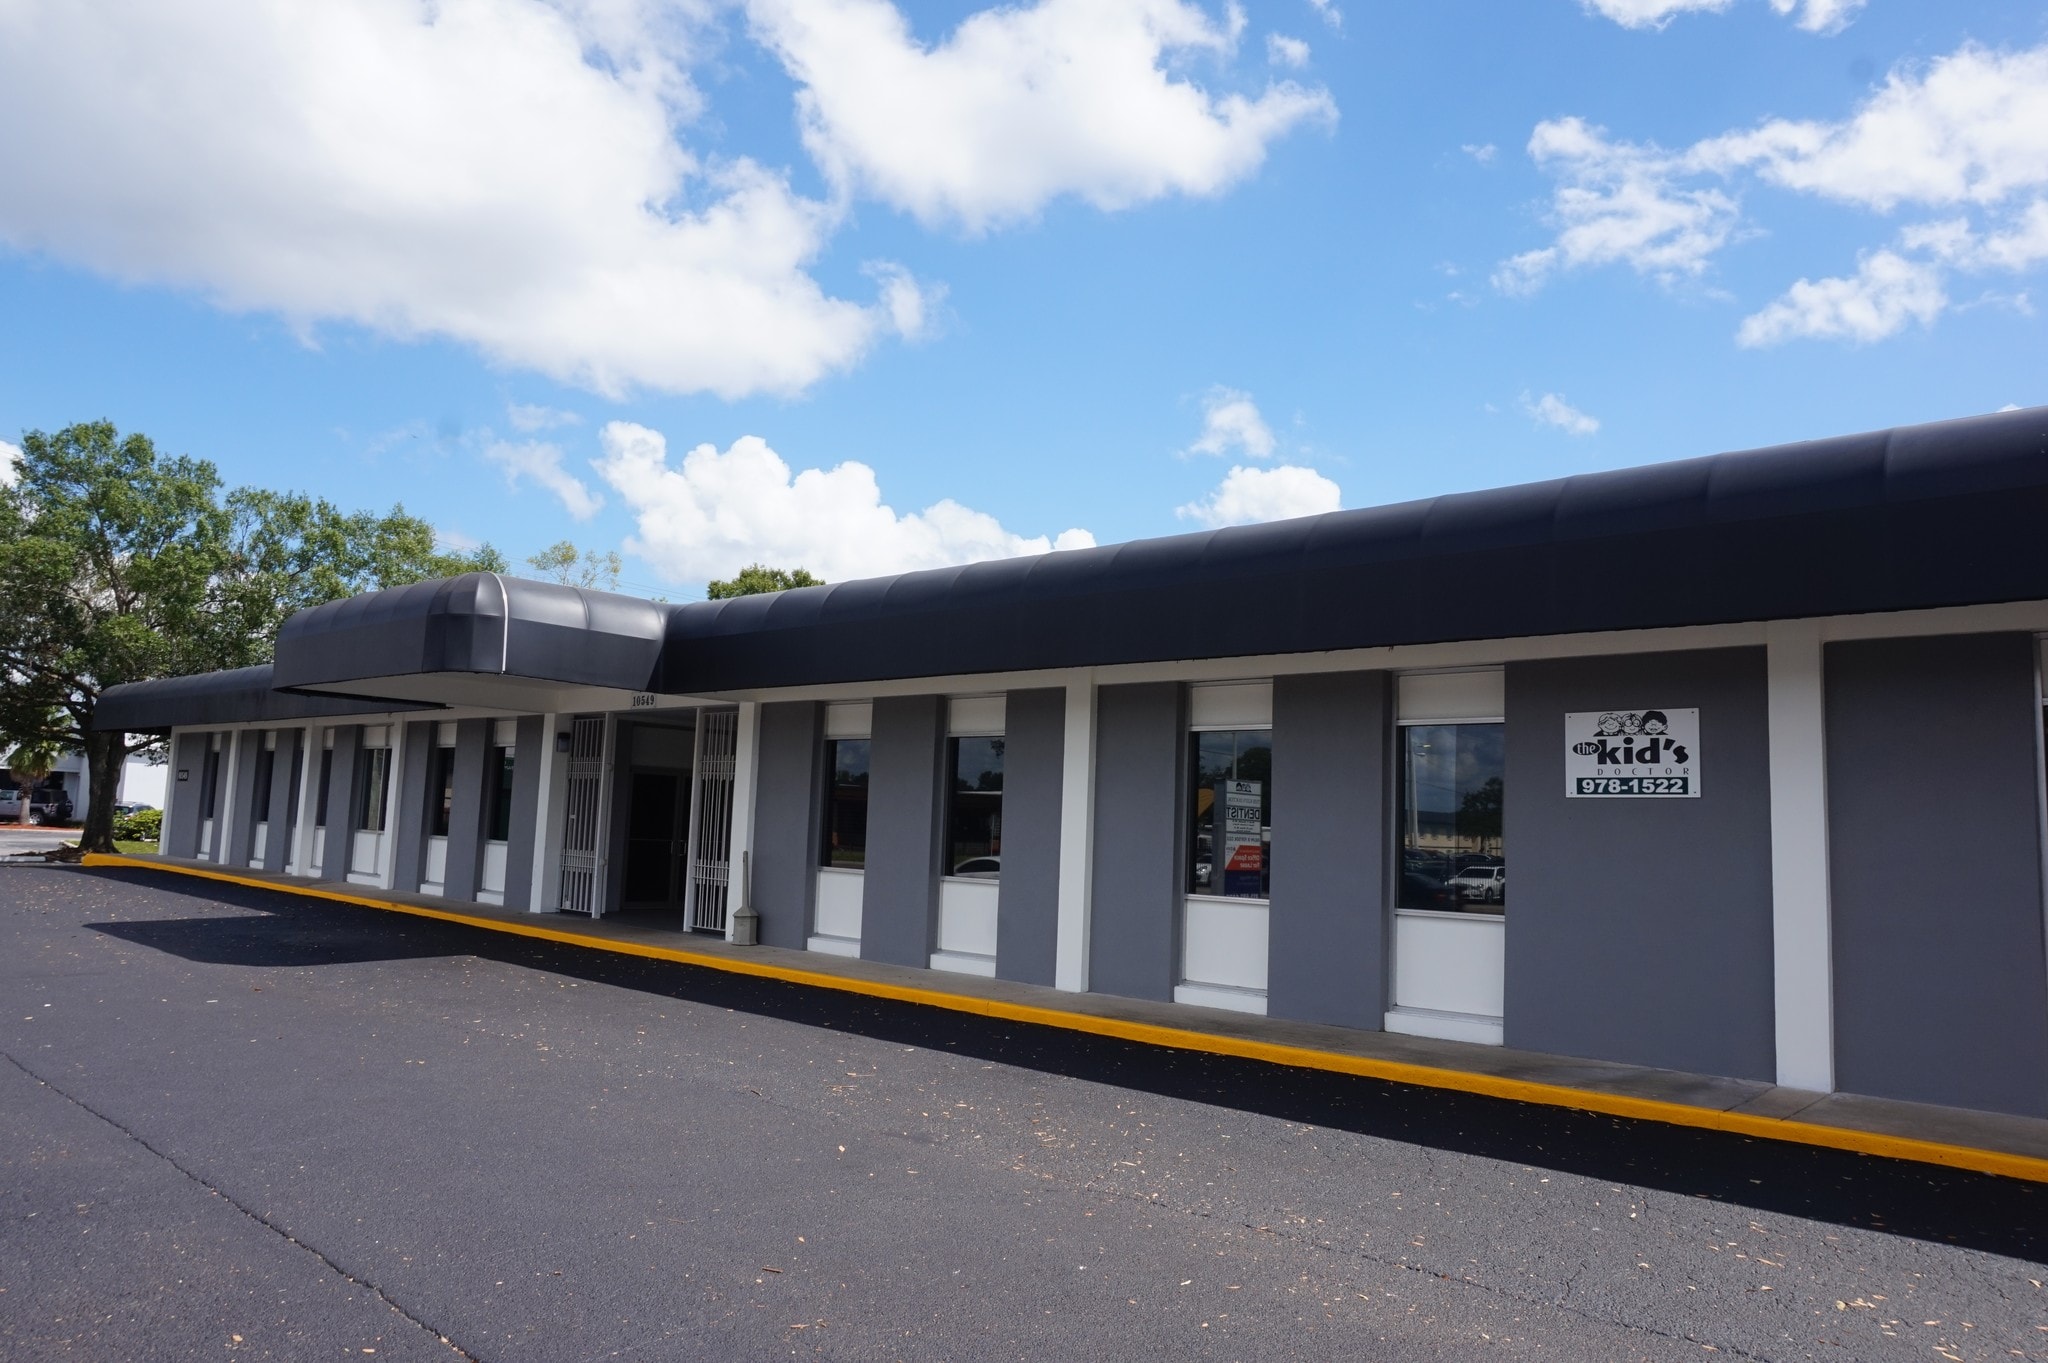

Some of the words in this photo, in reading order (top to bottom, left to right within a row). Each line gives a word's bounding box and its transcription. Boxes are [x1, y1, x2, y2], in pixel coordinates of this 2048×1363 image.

[632, 694, 655, 707] 10549
[1577, 741, 1596, 755] the
[1597, 736, 1689, 765] kid's
[1597, 767, 1690, 776] DOCTOR
[1581, 778, 1684, 793] 978-1522
